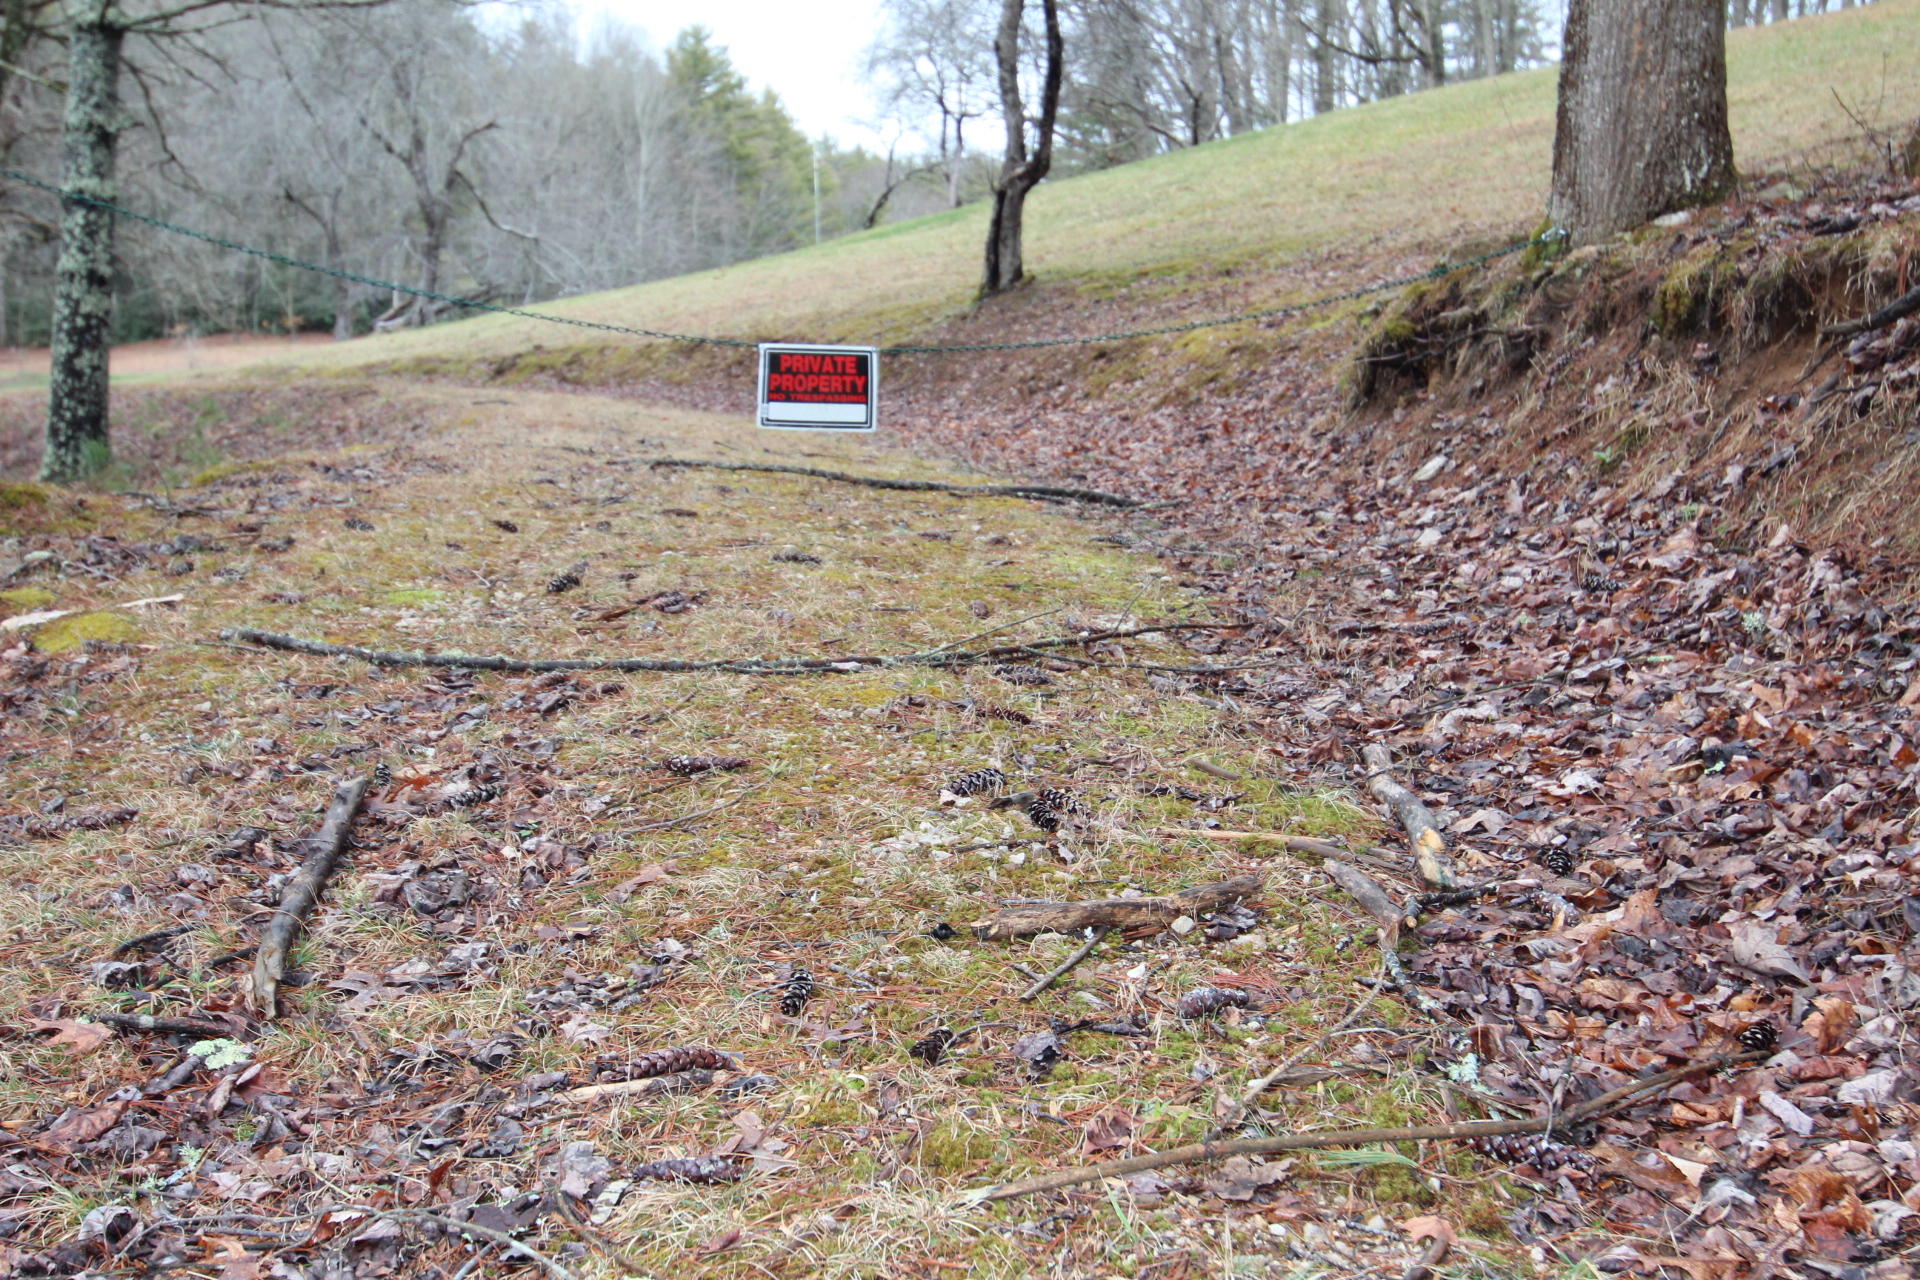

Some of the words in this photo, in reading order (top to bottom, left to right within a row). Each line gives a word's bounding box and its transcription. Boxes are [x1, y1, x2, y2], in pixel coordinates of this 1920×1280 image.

[780, 354, 857, 373] PRIVATE
[769, 373, 866, 393] PROPERTY
[769, 393, 786, 401] NO
